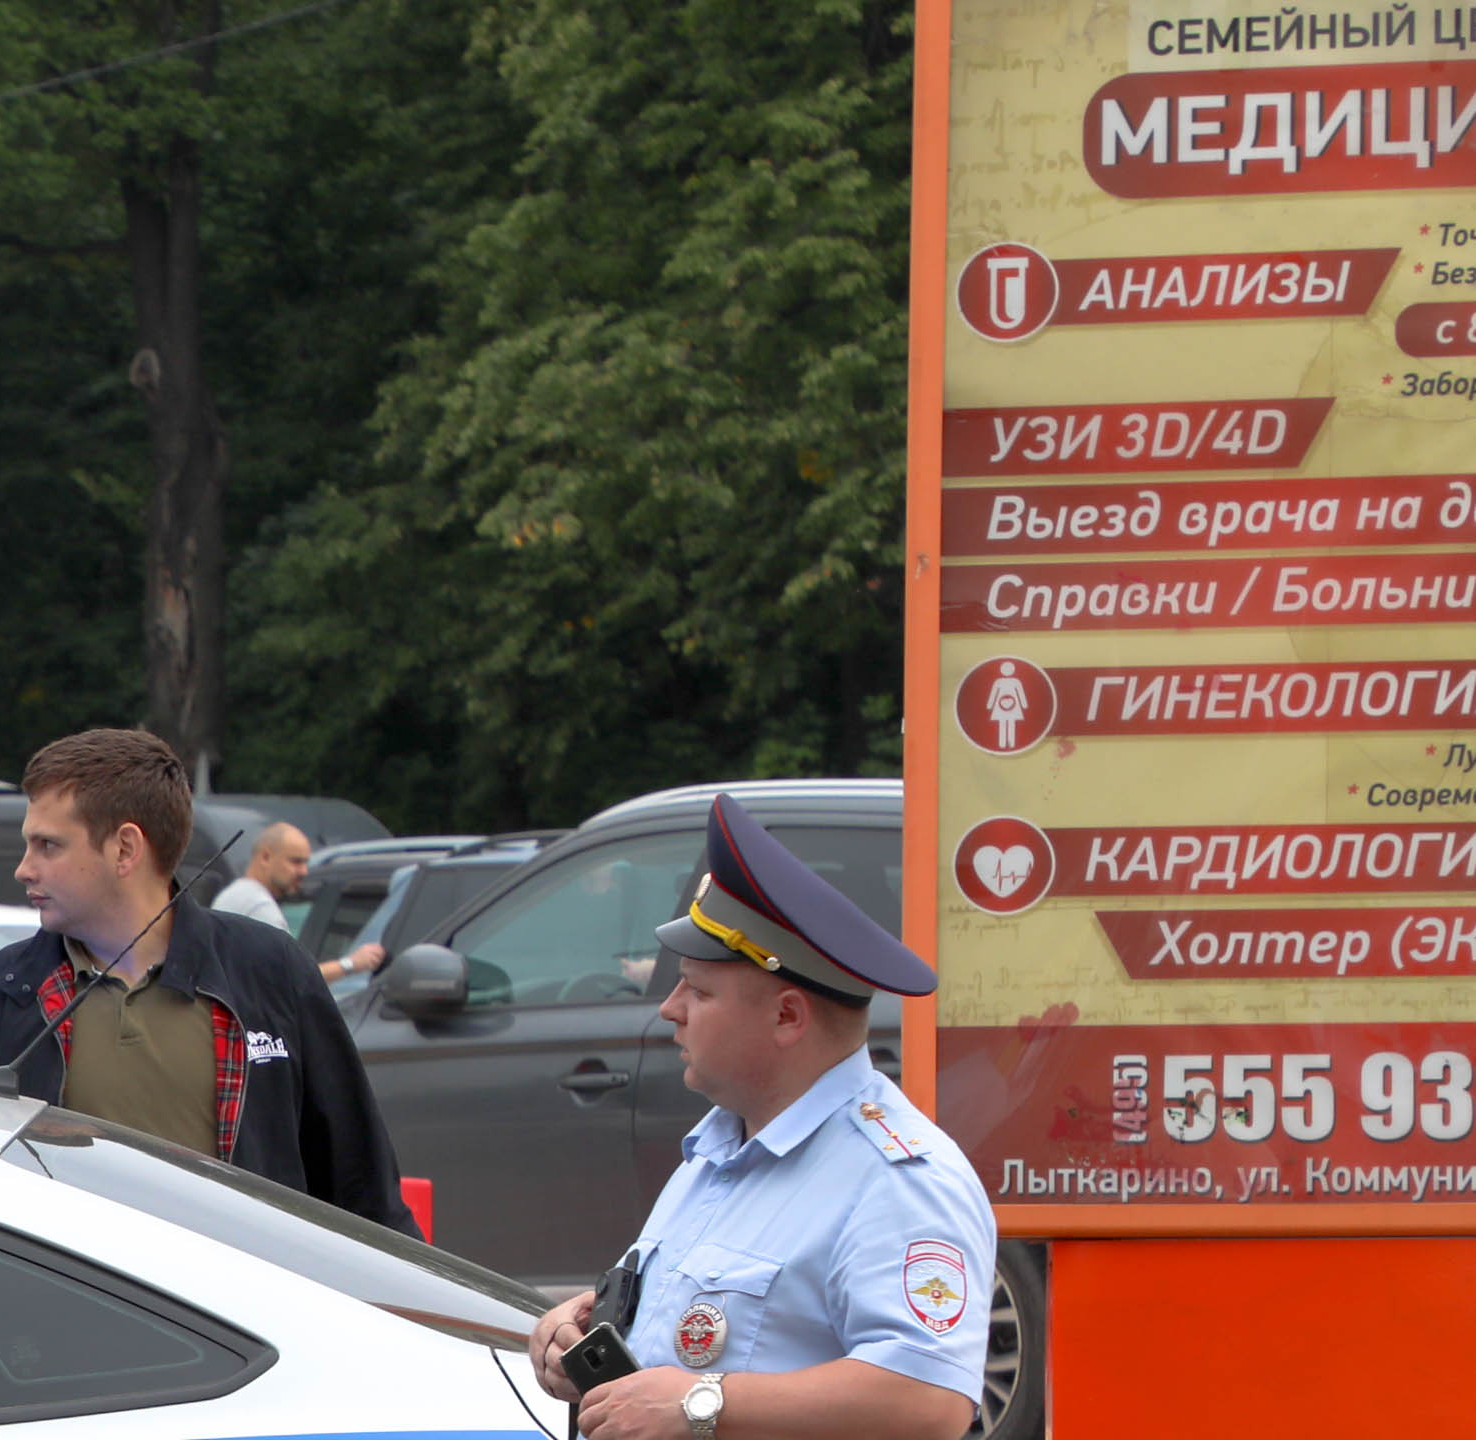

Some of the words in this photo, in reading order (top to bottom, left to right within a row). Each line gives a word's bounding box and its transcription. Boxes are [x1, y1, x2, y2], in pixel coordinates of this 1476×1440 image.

[1148, 3, 1415, 56] СЕМЕЙНЫЙ
[1079, 260, 1351, 311] АНАЛИЗЫ
[989, 413, 1101, 463] УЗИ
[1115, 409, 1288, 460] 3D/4D
[987, 490, 1162, 541] Выезд
[1178, 496, 1341, 546] врача
[1355, 496, 1423, 531] на
[1440, 481, 1476, 529] д
[987, 573, 1217, 628] Справки
[1273, 566, 1476, 613] Больни
[1086, 669, 1476, 722] ГИНЕКОЛОГИ
[1367, 782, 1476, 813] Соврем
[1085, 831, 1476, 890] КАРДИОЛОГИ
[1149, 920, 1371, 976] Холтер
[1163, 1053, 1336, 1143] 555
[1360, 1050, 1474, 1142] 93
[998, 1158, 1224, 1203] Лыткарино,
[1237, 1166, 1291, 1203] ул.
